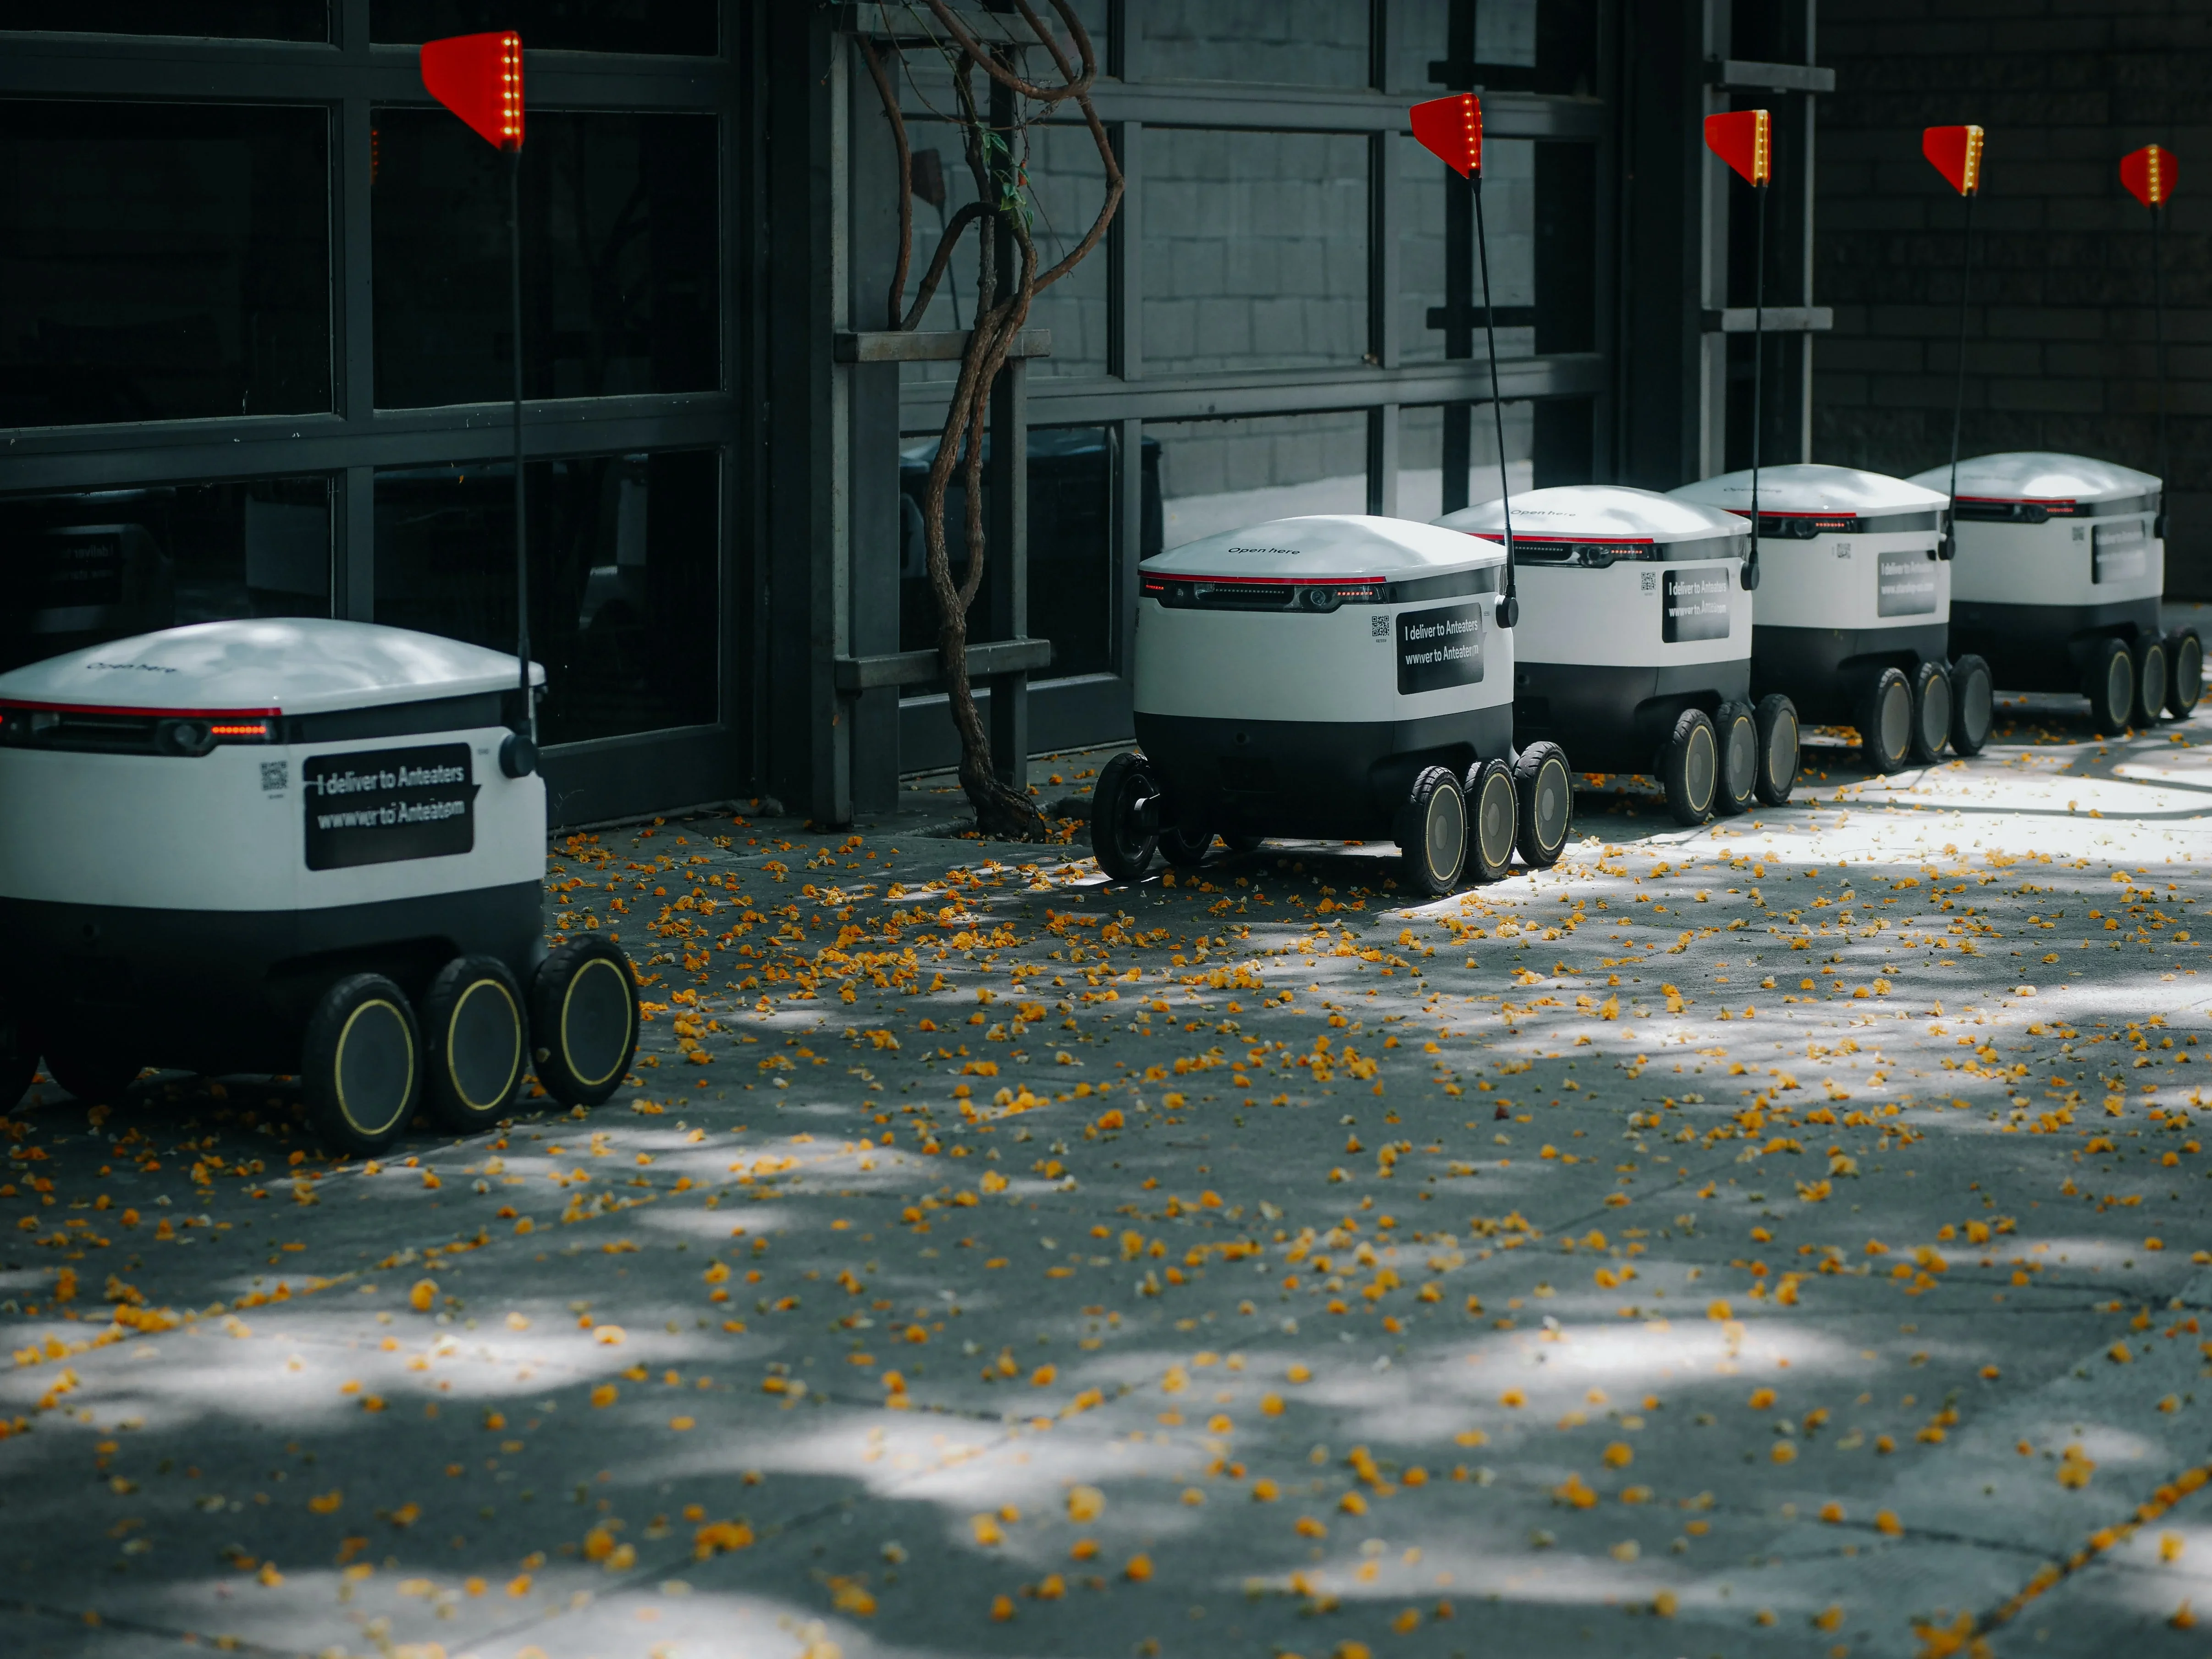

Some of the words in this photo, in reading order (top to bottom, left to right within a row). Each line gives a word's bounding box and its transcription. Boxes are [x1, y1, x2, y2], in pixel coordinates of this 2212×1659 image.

[1669, 582, 1672, 596] I
[1673, 581, 1693, 595] deliver
[1694, 582, 1700, 594] to
[1701, 580, 1727, 594] Anteaters
[1405, 626, 1408, 641] I
[1410, 624, 1436, 640] deliver
[1437, 623, 1445, 636] to
[1446, 619, 1478, 635] Anteaters
[1434, 649, 1442, 662] to
[317, 774, 324, 795] I
[326, 771, 379, 795] deliver
[379, 770, 396, 789] to
[397, 765, 465, 787] Anteaters
[380, 806, 396, 825] to
